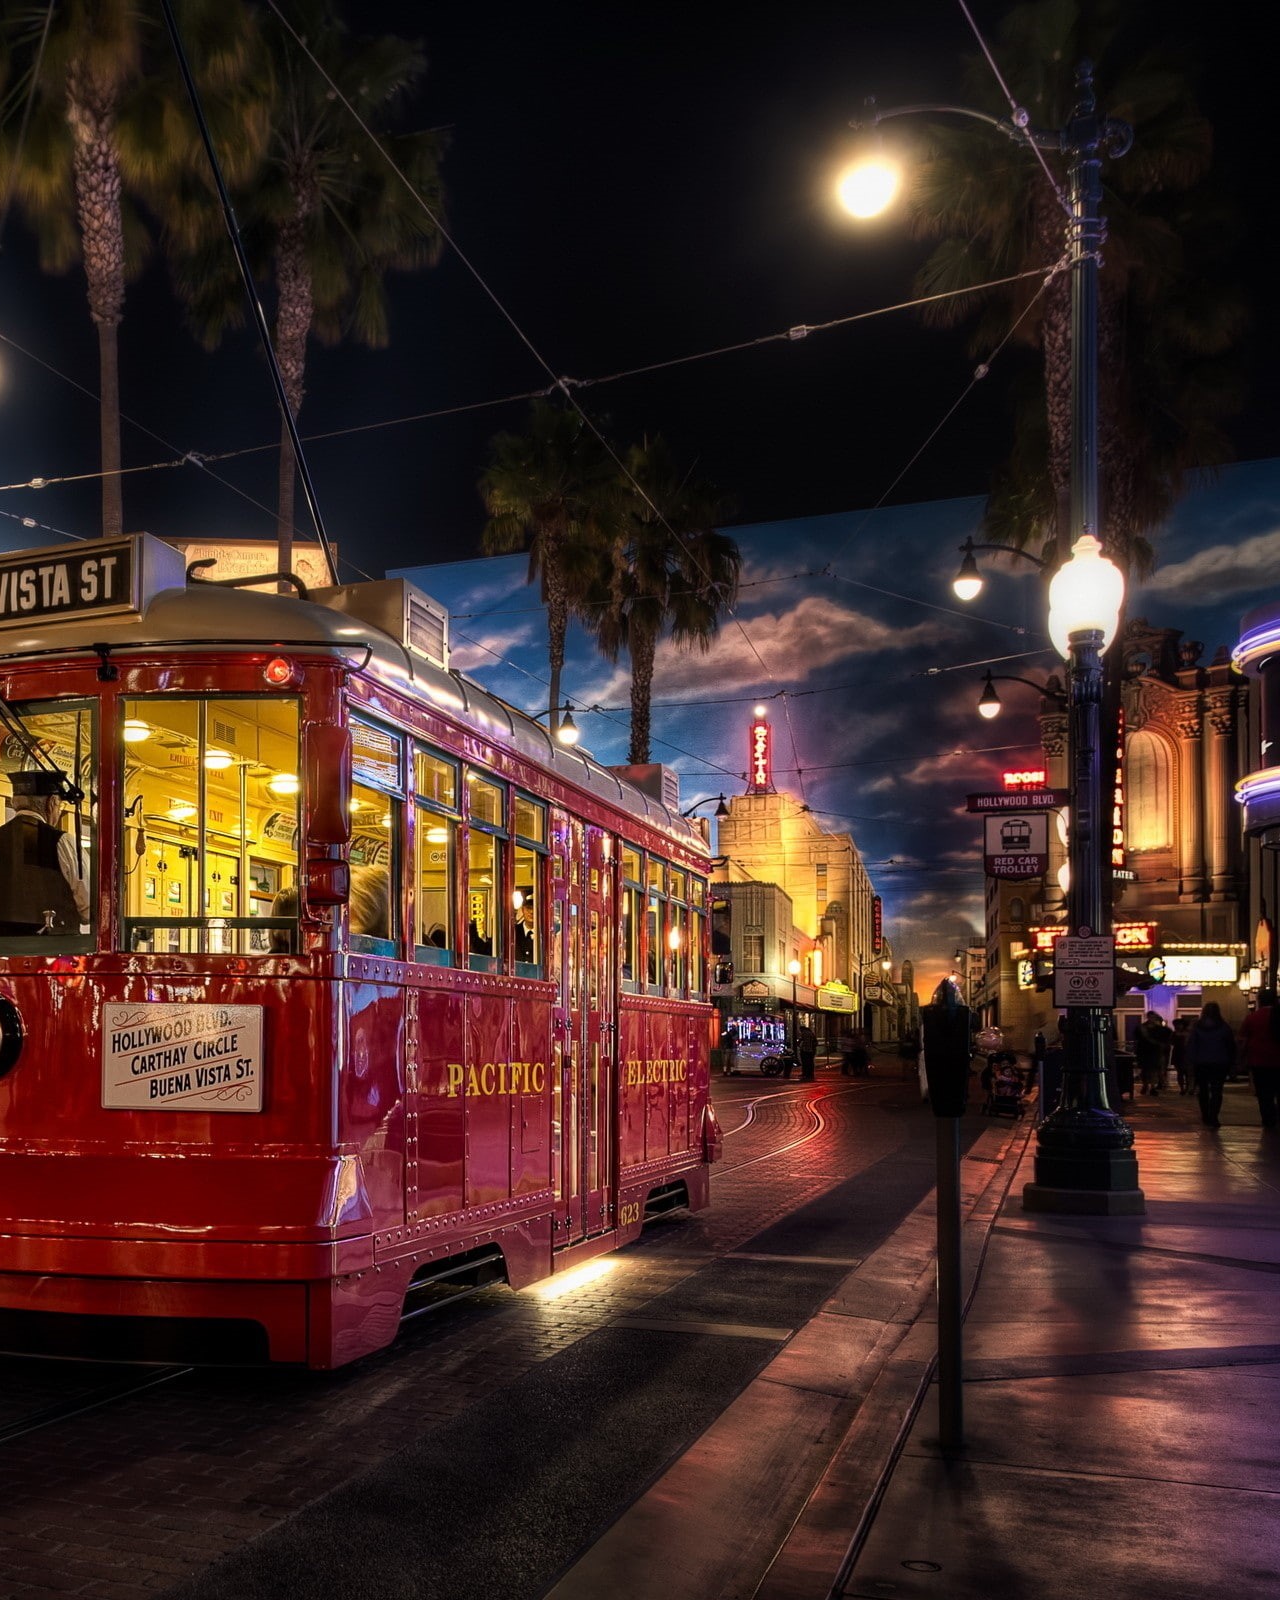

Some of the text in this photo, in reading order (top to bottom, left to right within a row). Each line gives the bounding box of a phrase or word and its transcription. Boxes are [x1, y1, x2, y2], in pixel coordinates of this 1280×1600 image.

[80, 556, 117, 601] ST
[977, 794, 1056, 808] HOLLYWOOD BLVD.
[993, 865, 1039, 874] TROLLEY
[994, 856, 1038, 866] RED CAR
[111, 1010, 232, 1054] HOLLYWOOD BLVD.
[131, 1034, 238, 1076] CARTHAY CIRCLE
[149, 1058, 254, 1099] BUENA VISTA ST.
[447, 1062, 545, 1098] PACIFIC
[627, 1060, 687, 1086] ELECTRIC
[621, 1202, 639, 1227] 623
